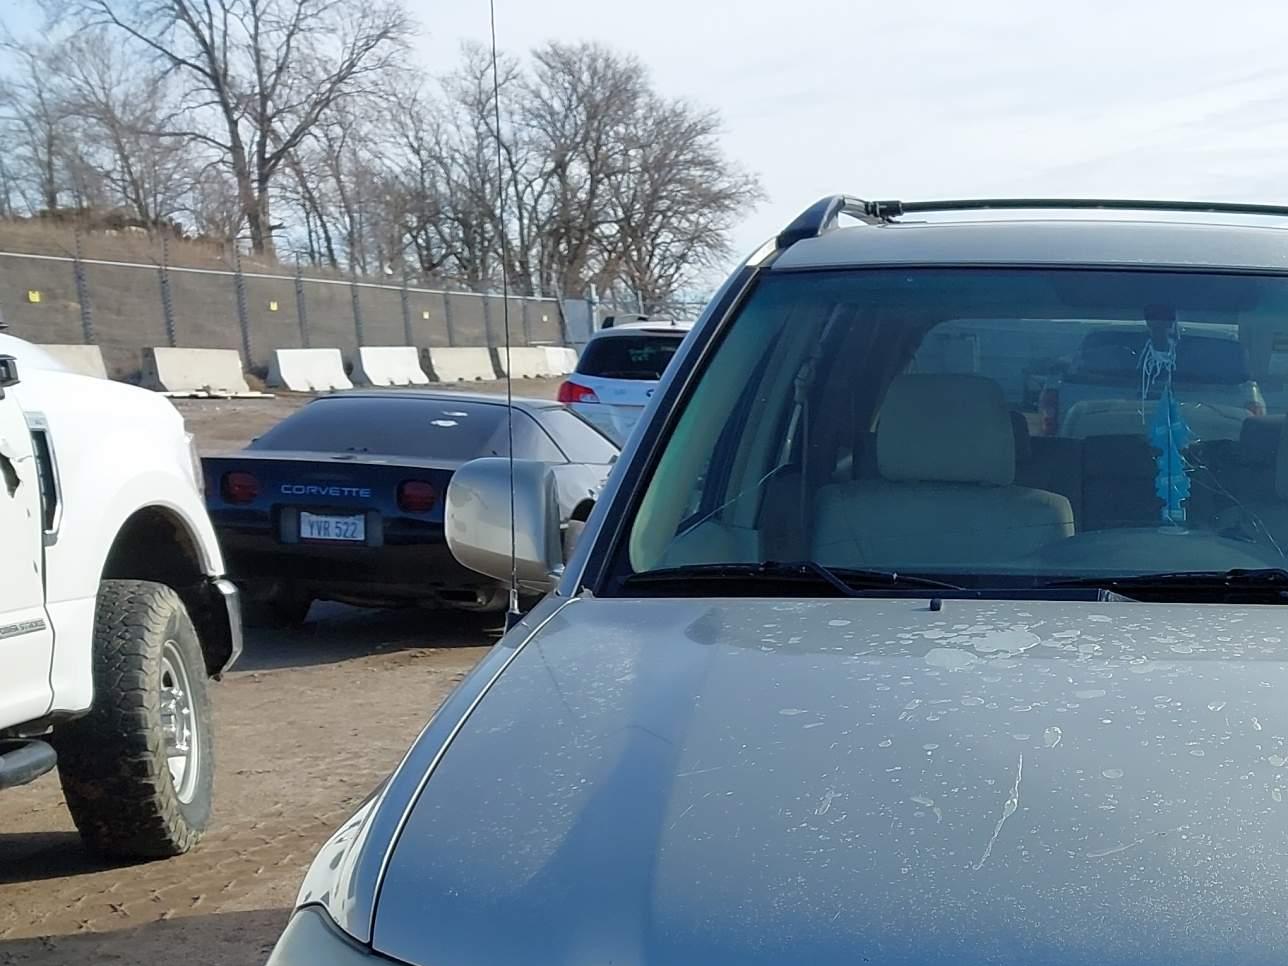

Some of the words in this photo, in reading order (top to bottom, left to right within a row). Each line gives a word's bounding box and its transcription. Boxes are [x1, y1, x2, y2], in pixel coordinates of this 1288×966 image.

[280, 484, 371, 498] CORVETTE
[308, 521, 330, 537] YVR
[335, 521, 358, 538] 522
